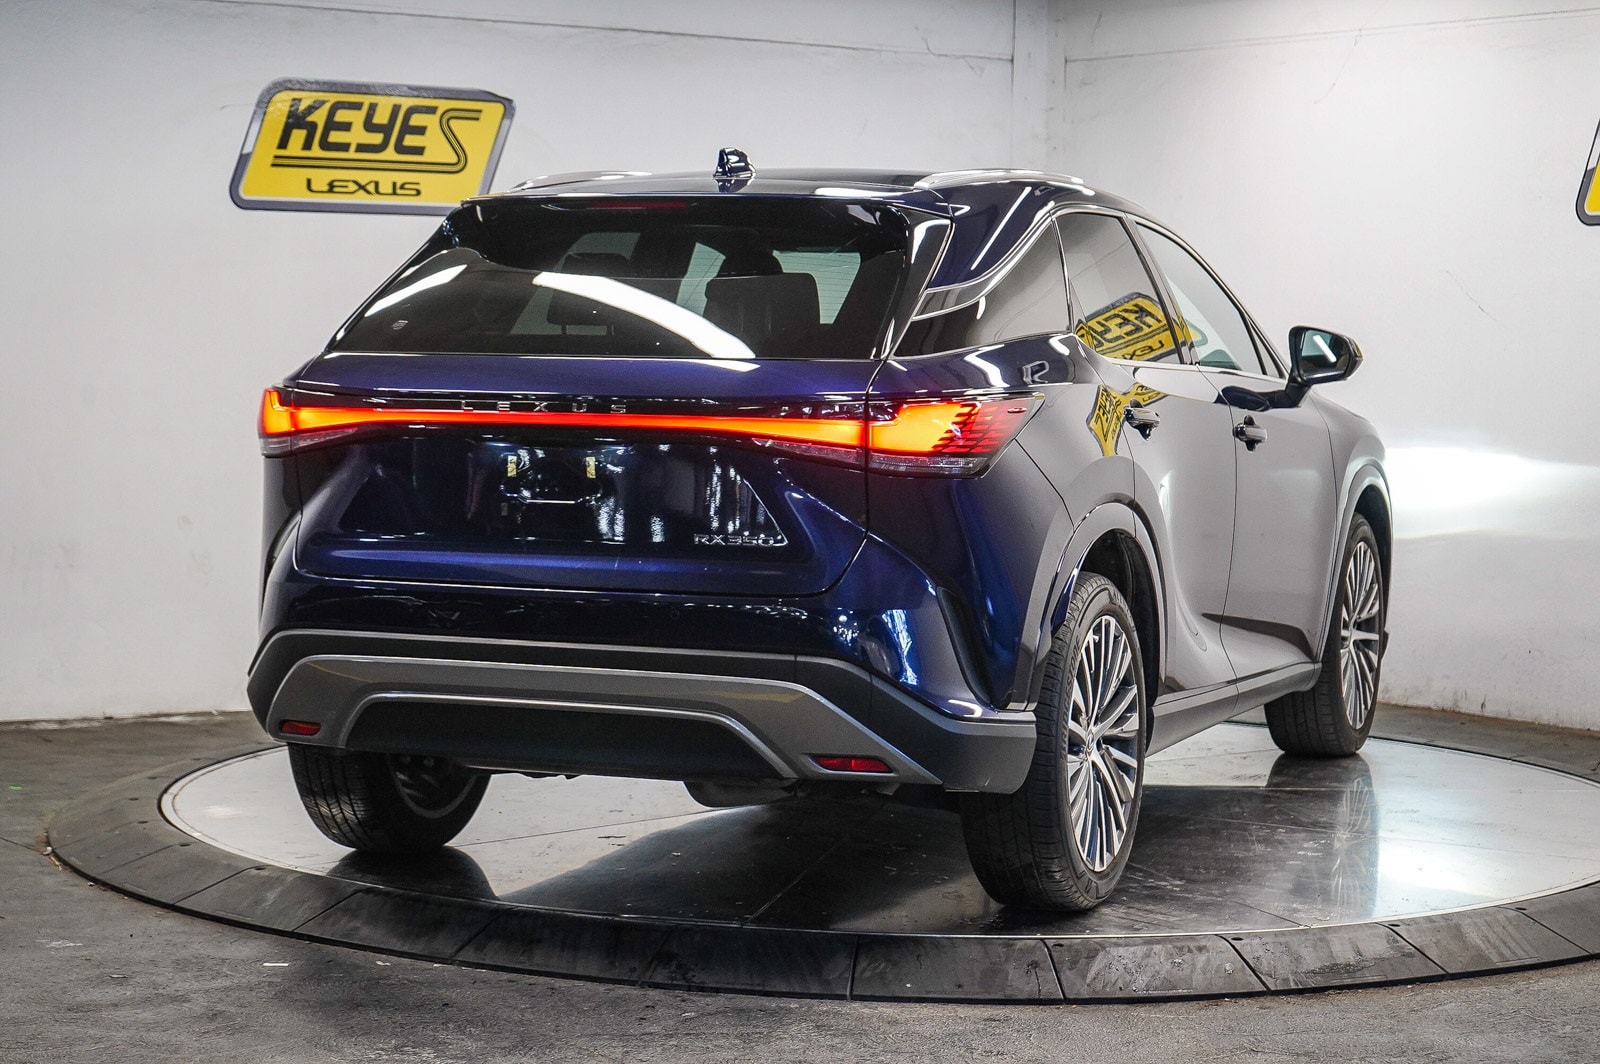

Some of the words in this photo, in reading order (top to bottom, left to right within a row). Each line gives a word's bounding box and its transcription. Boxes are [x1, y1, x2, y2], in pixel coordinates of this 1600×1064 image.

[271, 97, 483, 174] KEYES
[306, 177, 422, 197] LEXUS
[460, 400, 628, 414] LEXUS
